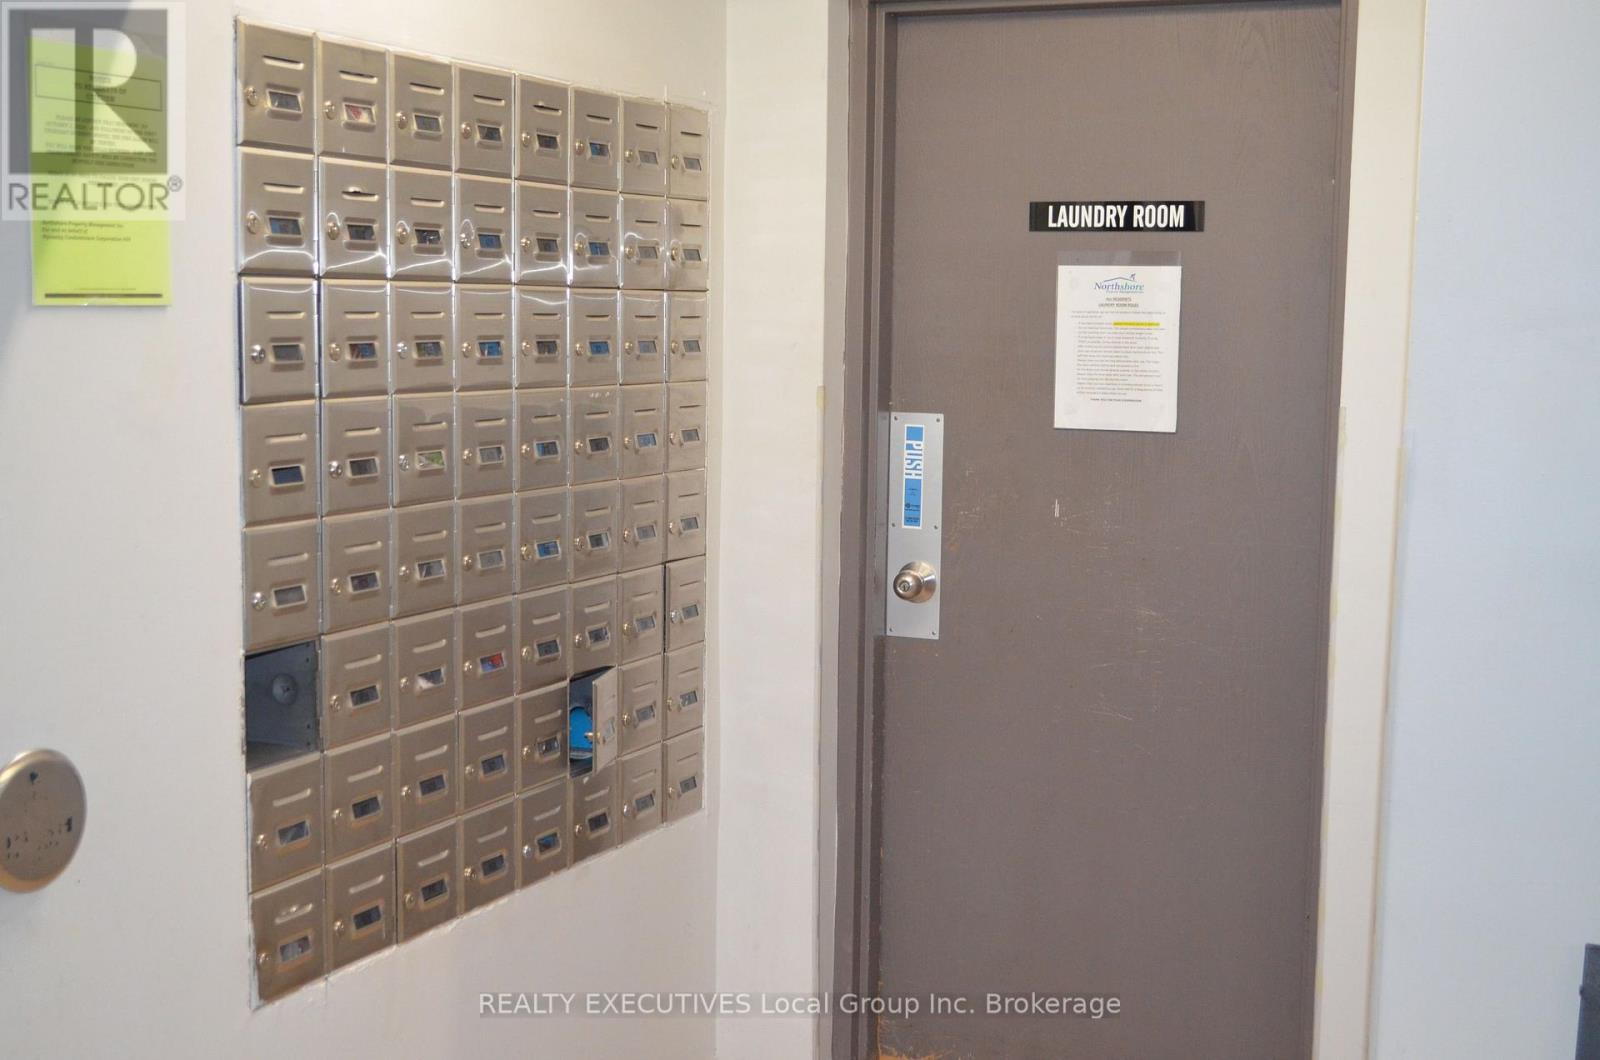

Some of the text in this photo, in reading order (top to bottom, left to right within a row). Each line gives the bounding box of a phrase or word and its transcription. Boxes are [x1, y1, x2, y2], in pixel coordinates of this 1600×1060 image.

[1047, 204, 1185, 228] LAUNDRY ROOM
[1093, 281, 1145, 291] Northshore
[904, 439, 924, 479] PUSH
